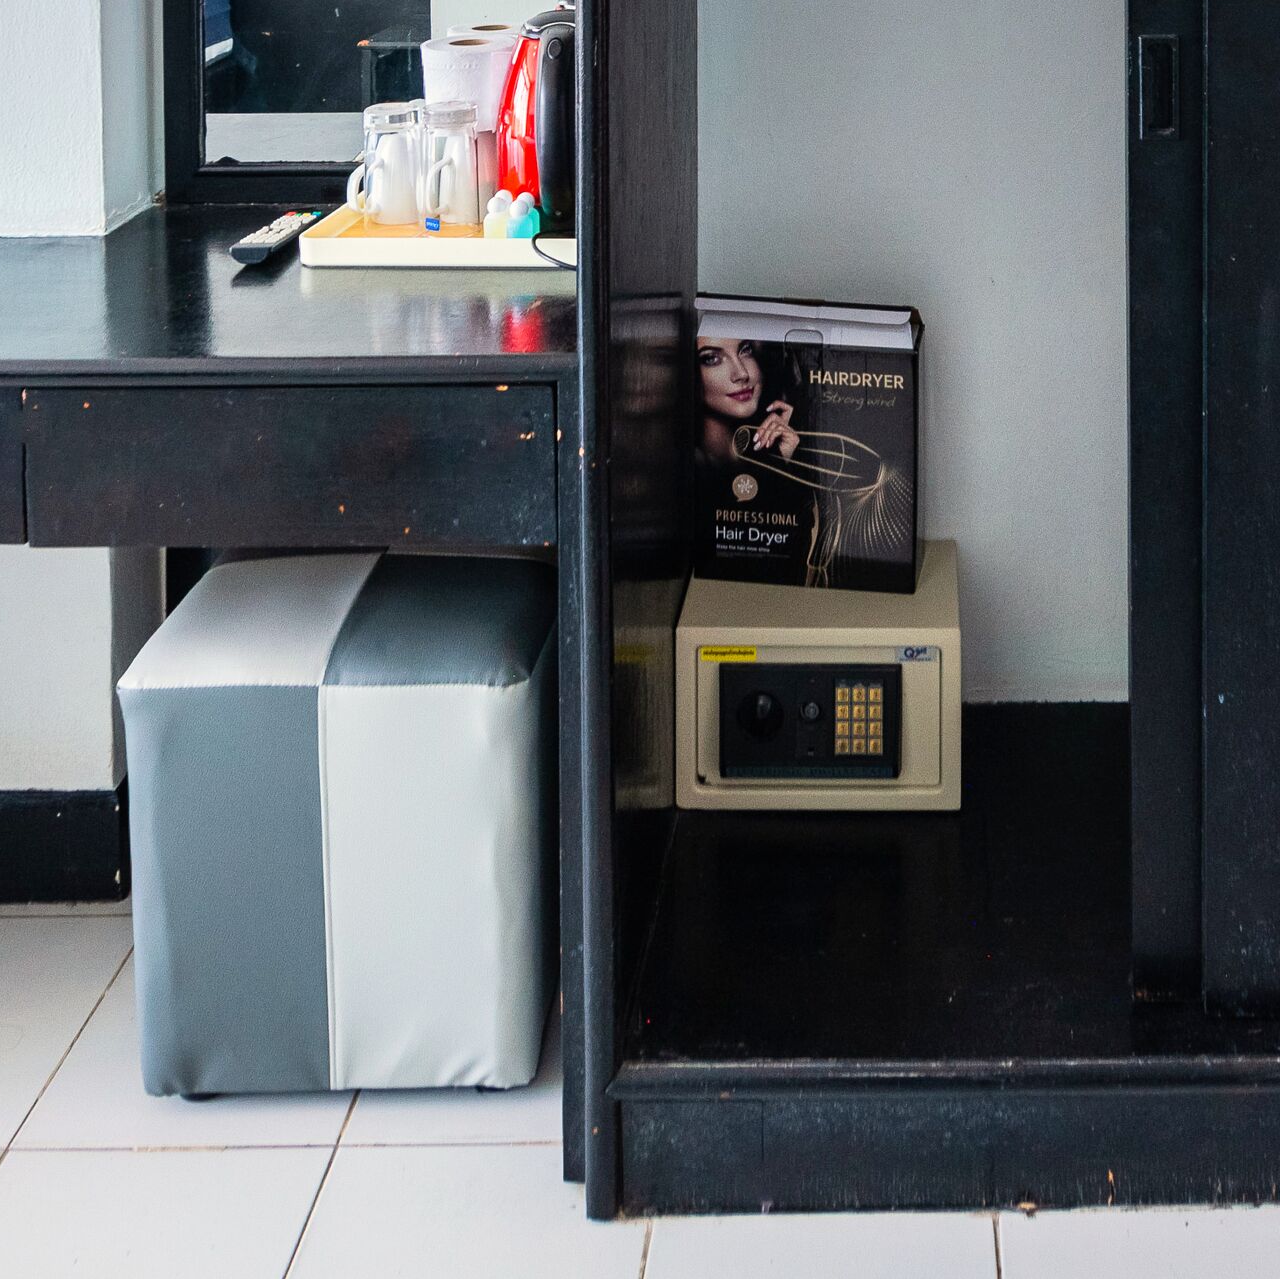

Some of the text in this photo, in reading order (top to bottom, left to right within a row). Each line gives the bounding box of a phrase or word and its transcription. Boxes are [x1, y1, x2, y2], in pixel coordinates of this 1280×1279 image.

[809, 370, 904, 389] HAIRDRYER
[822, 391, 897, 411] Strong wind
[715, 509, 799, 526] PROFESSIONAL
[715, 525, 789, 546] Hair Dryer
